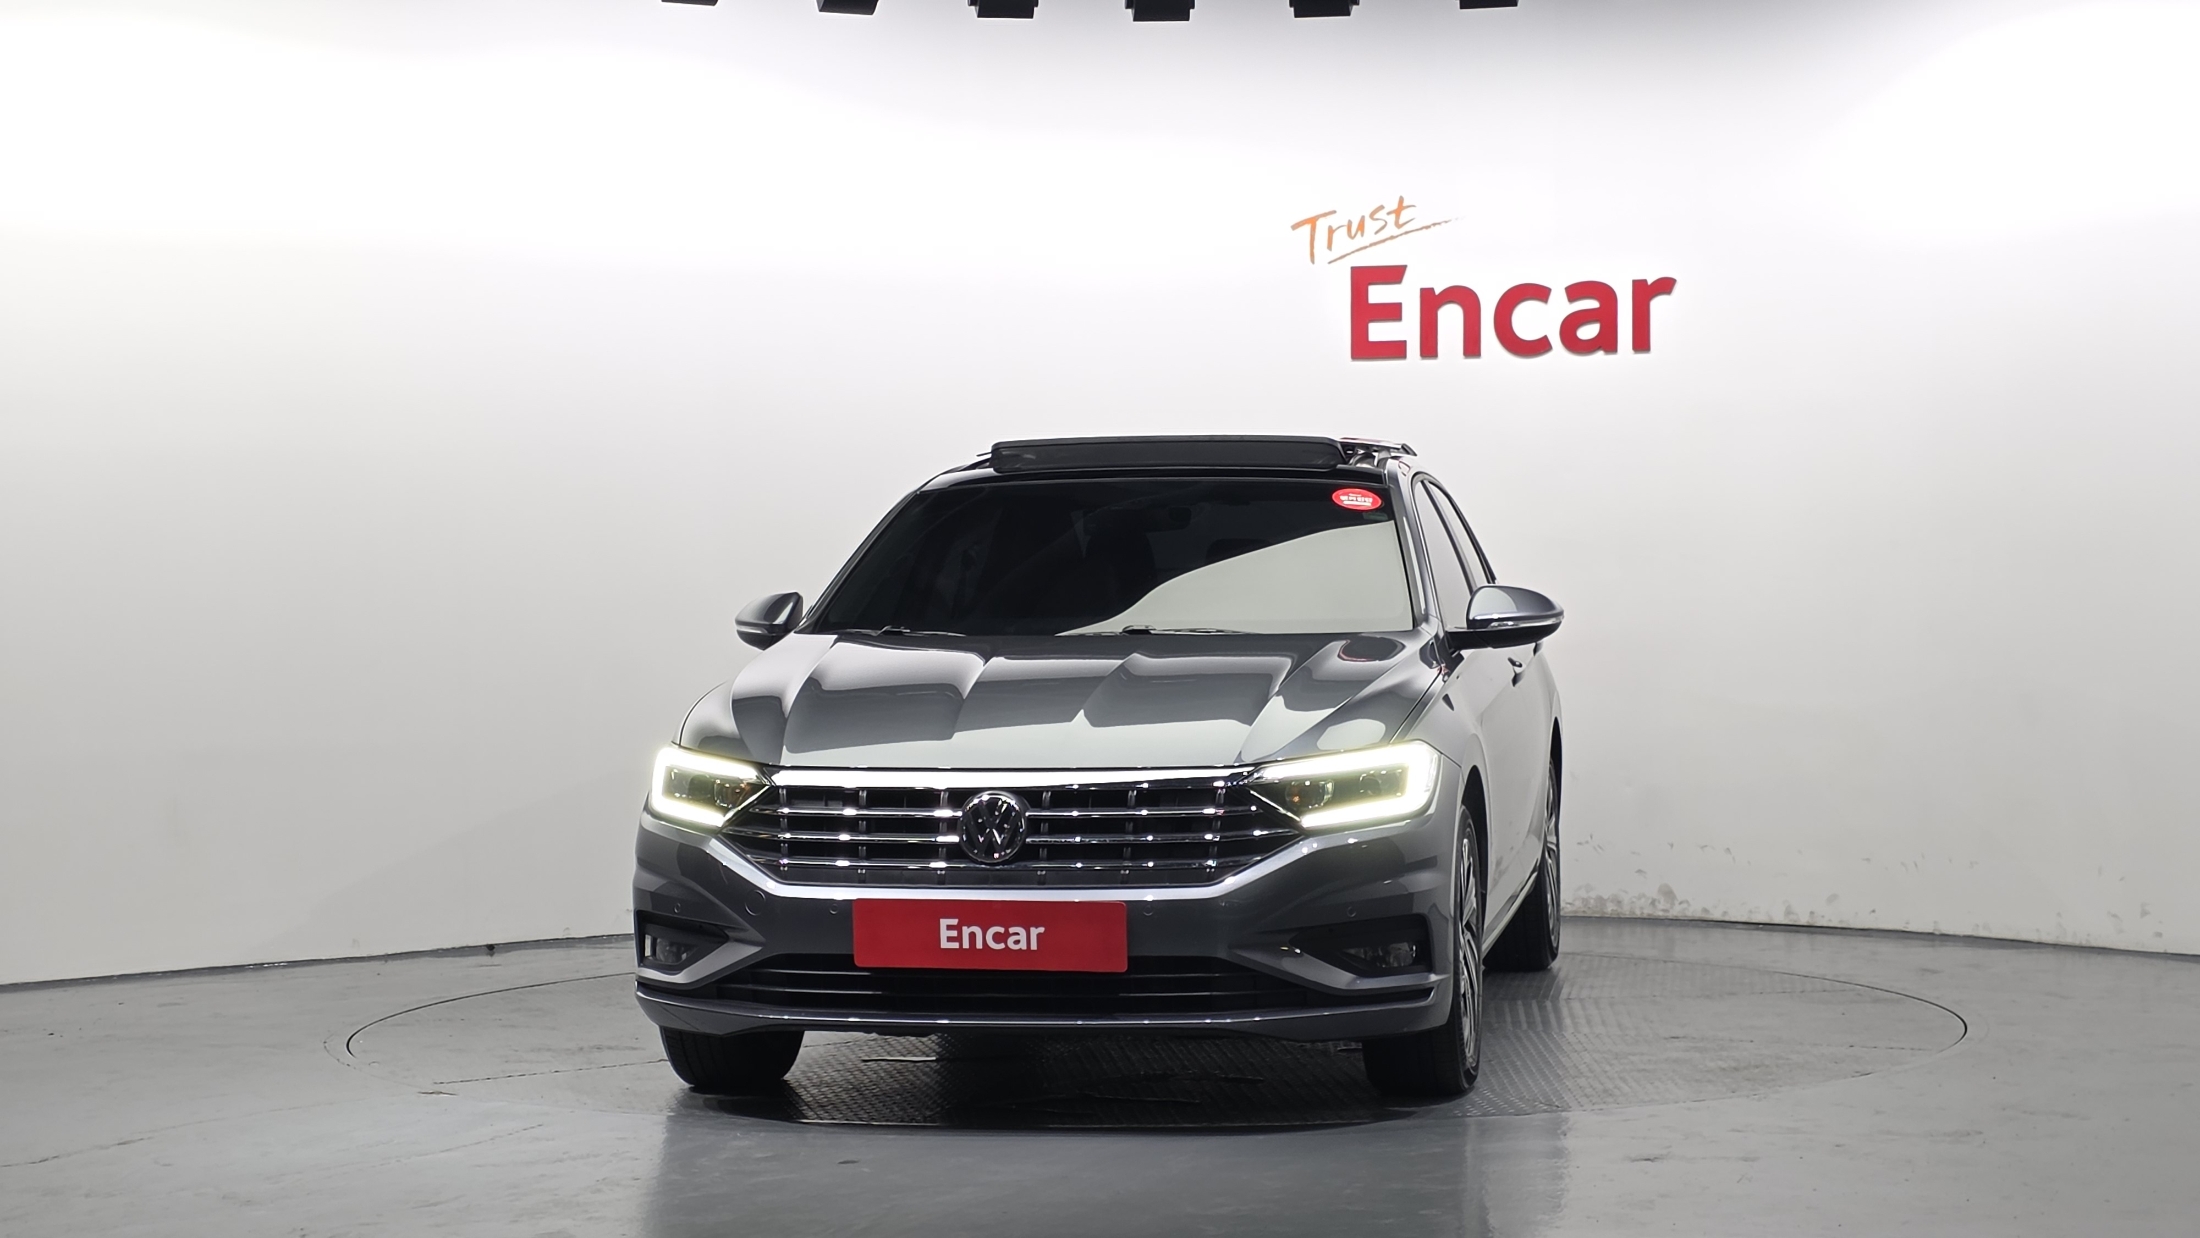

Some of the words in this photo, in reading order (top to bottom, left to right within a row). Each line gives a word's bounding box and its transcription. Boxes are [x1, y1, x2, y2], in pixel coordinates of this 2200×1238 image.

[1291, 195, 1417, 264] Trust
[1350, 264, 1677, 360] Encar
[939, 918, 1045, 950] Encar
